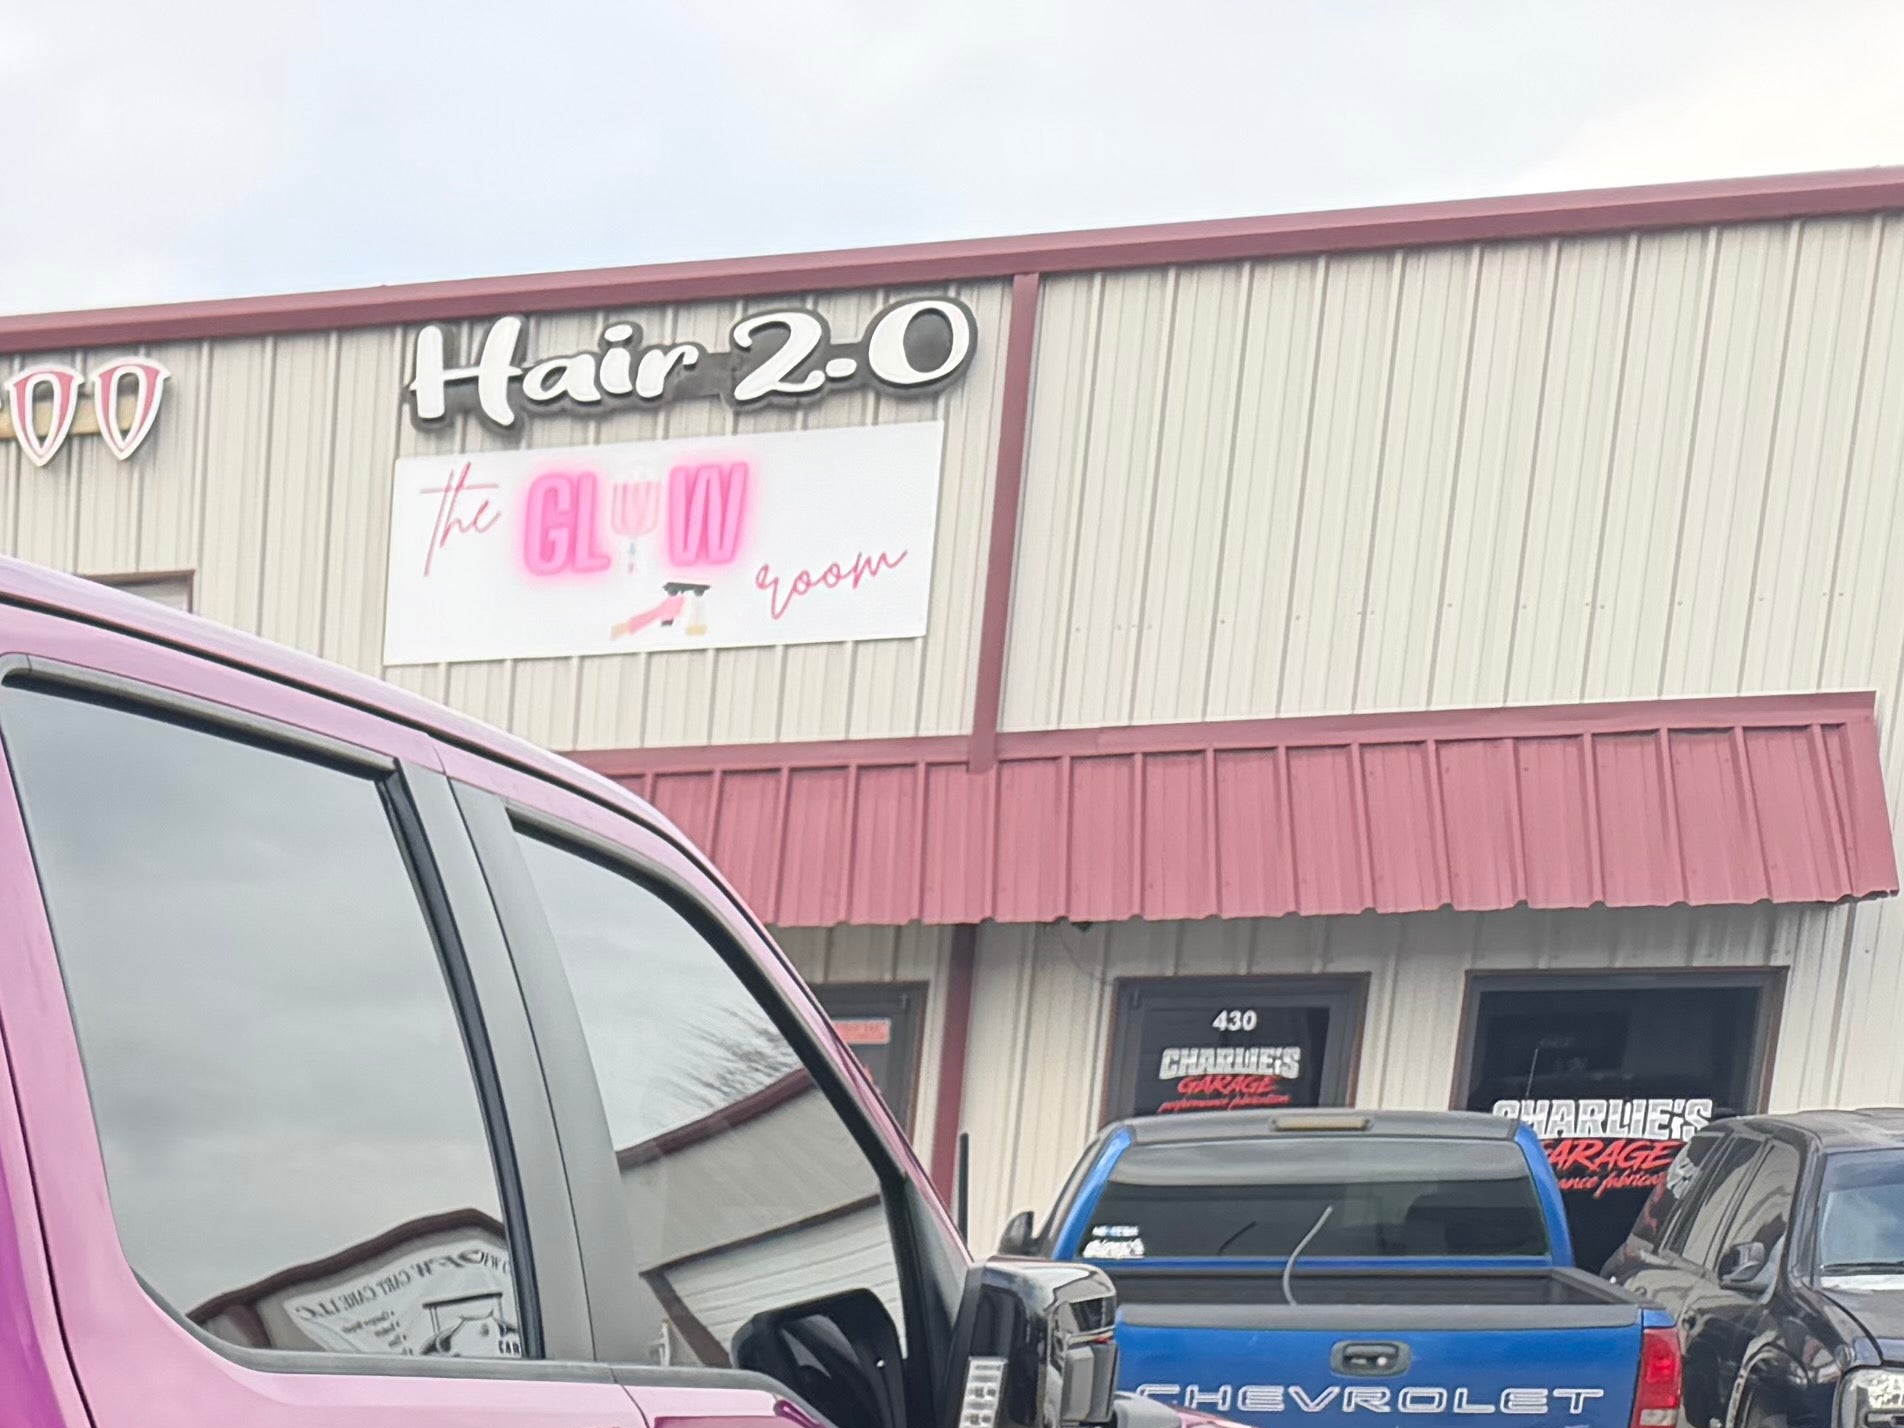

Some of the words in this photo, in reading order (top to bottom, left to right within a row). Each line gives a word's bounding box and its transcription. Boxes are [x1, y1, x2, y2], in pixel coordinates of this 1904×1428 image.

[405, 314, 700, 427] Hair
[419, 460, 502, 577] the
[754, 548, 909, 620] room
[1211, 1009, 1258, 1032] 430
[1158, 1046, 1302, 1080] CHARLIE'S
[1176, 1074, 1280, 1095] GARAGE
[1542, 1139, 1686, 1173] ARAGE
